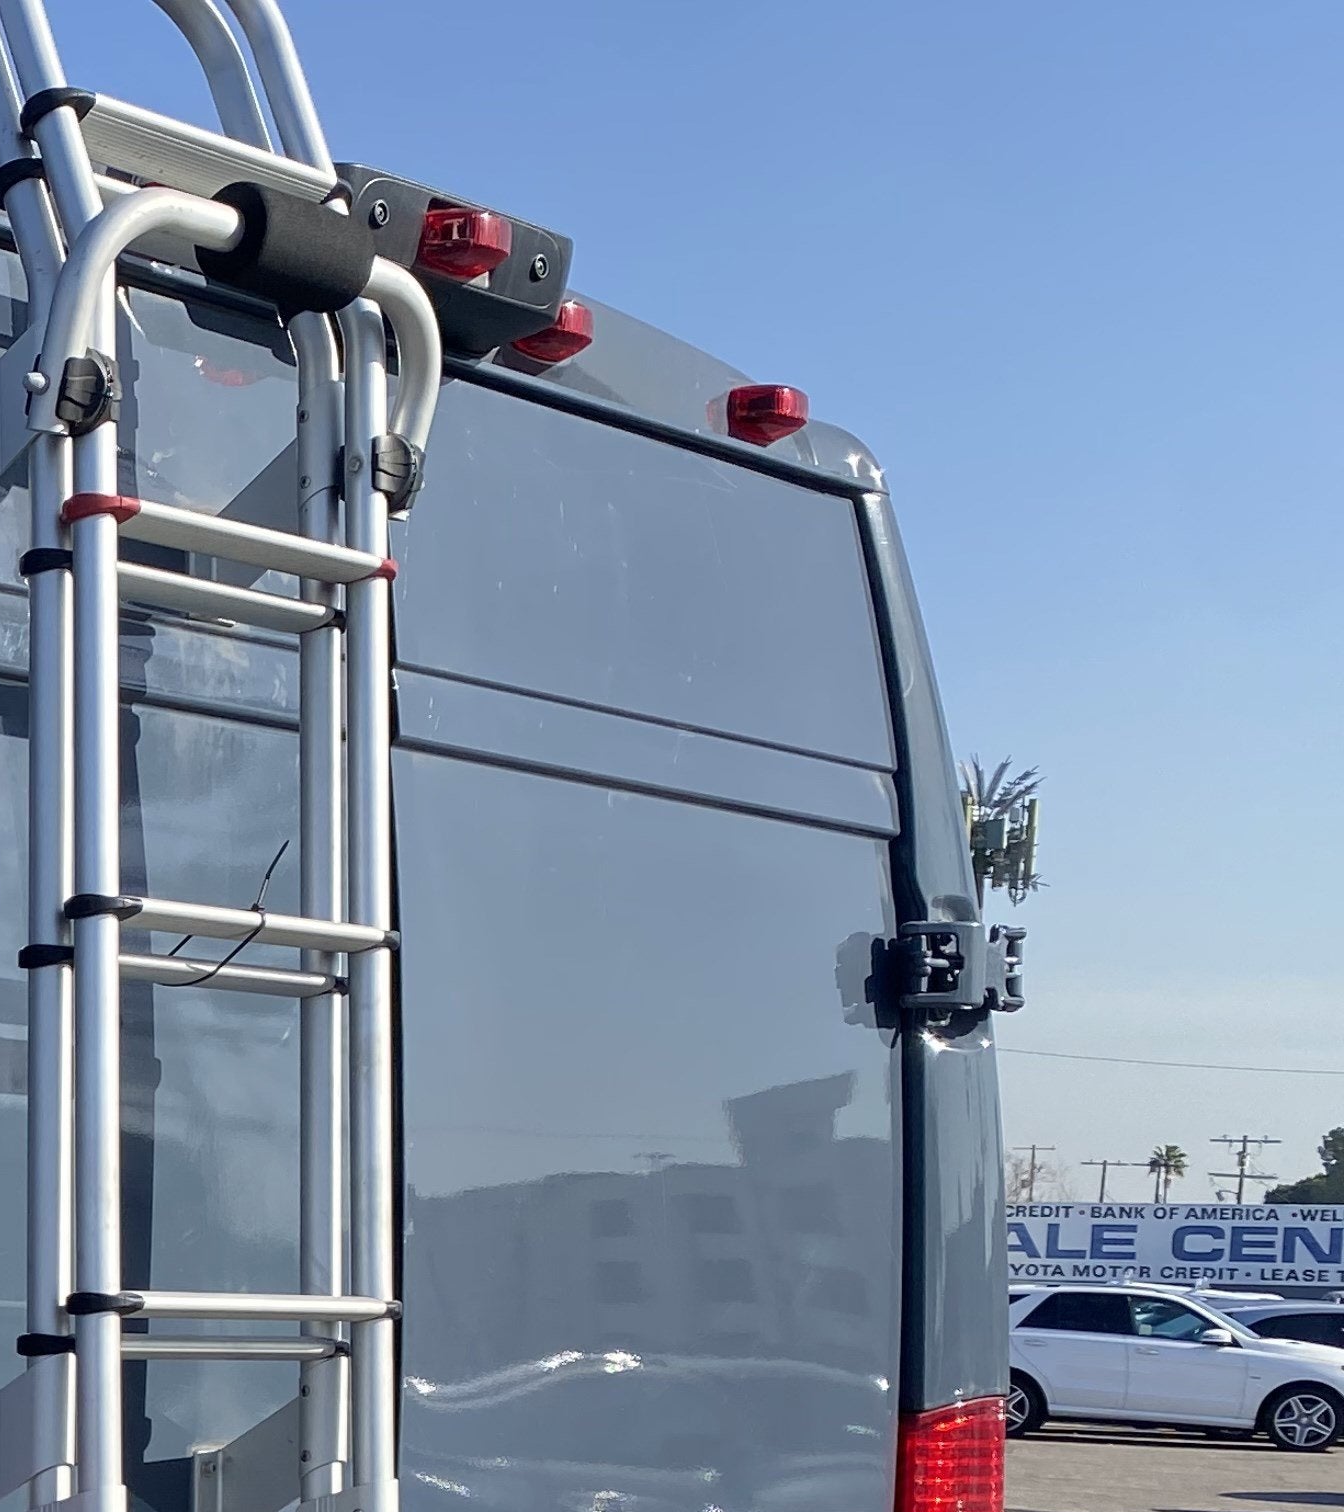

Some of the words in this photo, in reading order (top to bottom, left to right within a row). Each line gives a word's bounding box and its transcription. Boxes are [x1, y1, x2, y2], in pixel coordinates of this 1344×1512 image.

[1006, 1205, 1074, 1218] CREDIT
[1090, 1206, 1146, 1219] BANK
[1153, 1207, 1180, 1220] OF
[1184, 1207, 1280, 1221] AMERICA
[1007, 1222, 1138, 1260] ALE
[1172, 1225, 1344, 1264] CEN
[1010, 1263, 1065, 1277] YOTA
[1160, 1266, 1239, 1281] CREDIT
[1260, 1268, 1329, 1283] LEASE
